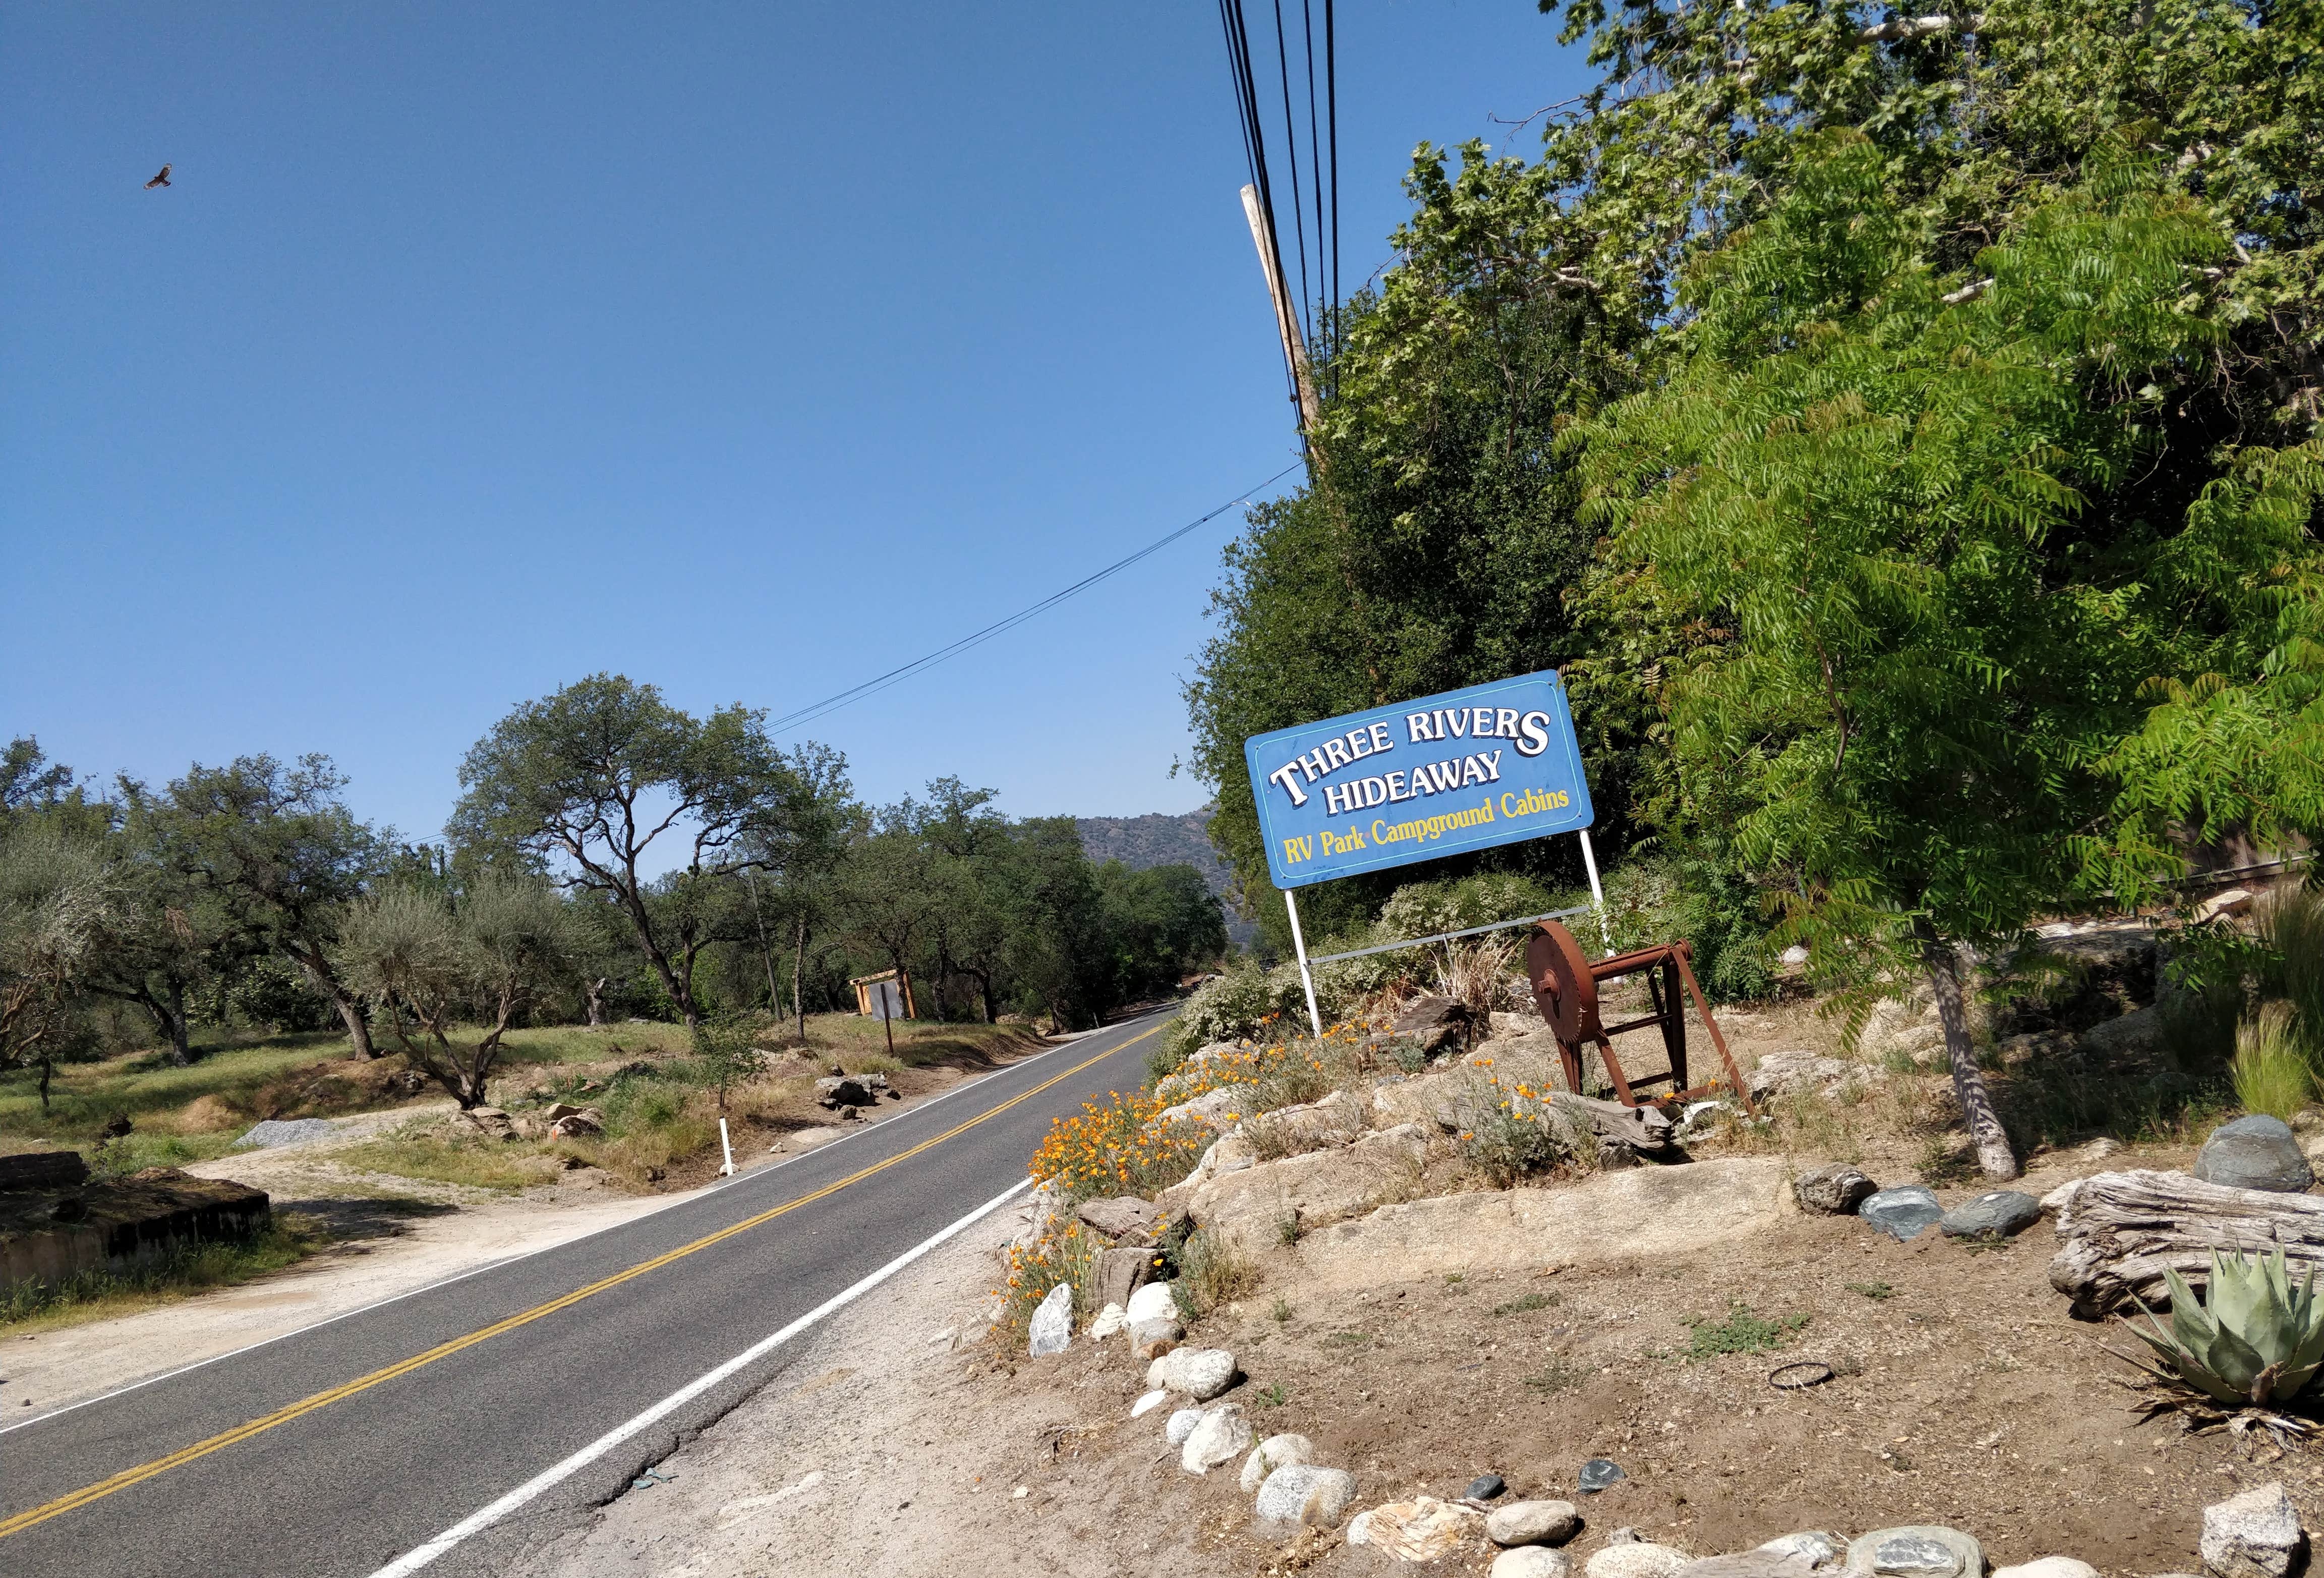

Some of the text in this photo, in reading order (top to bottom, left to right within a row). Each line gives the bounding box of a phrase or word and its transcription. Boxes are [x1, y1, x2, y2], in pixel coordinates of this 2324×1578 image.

[1268, 707, 1551, 810] THREE RIVERS
[1323, 750, 1502, 817] HIDEAWAY
[1283, 788, 1570, 864] RV Park Campground Cabins
